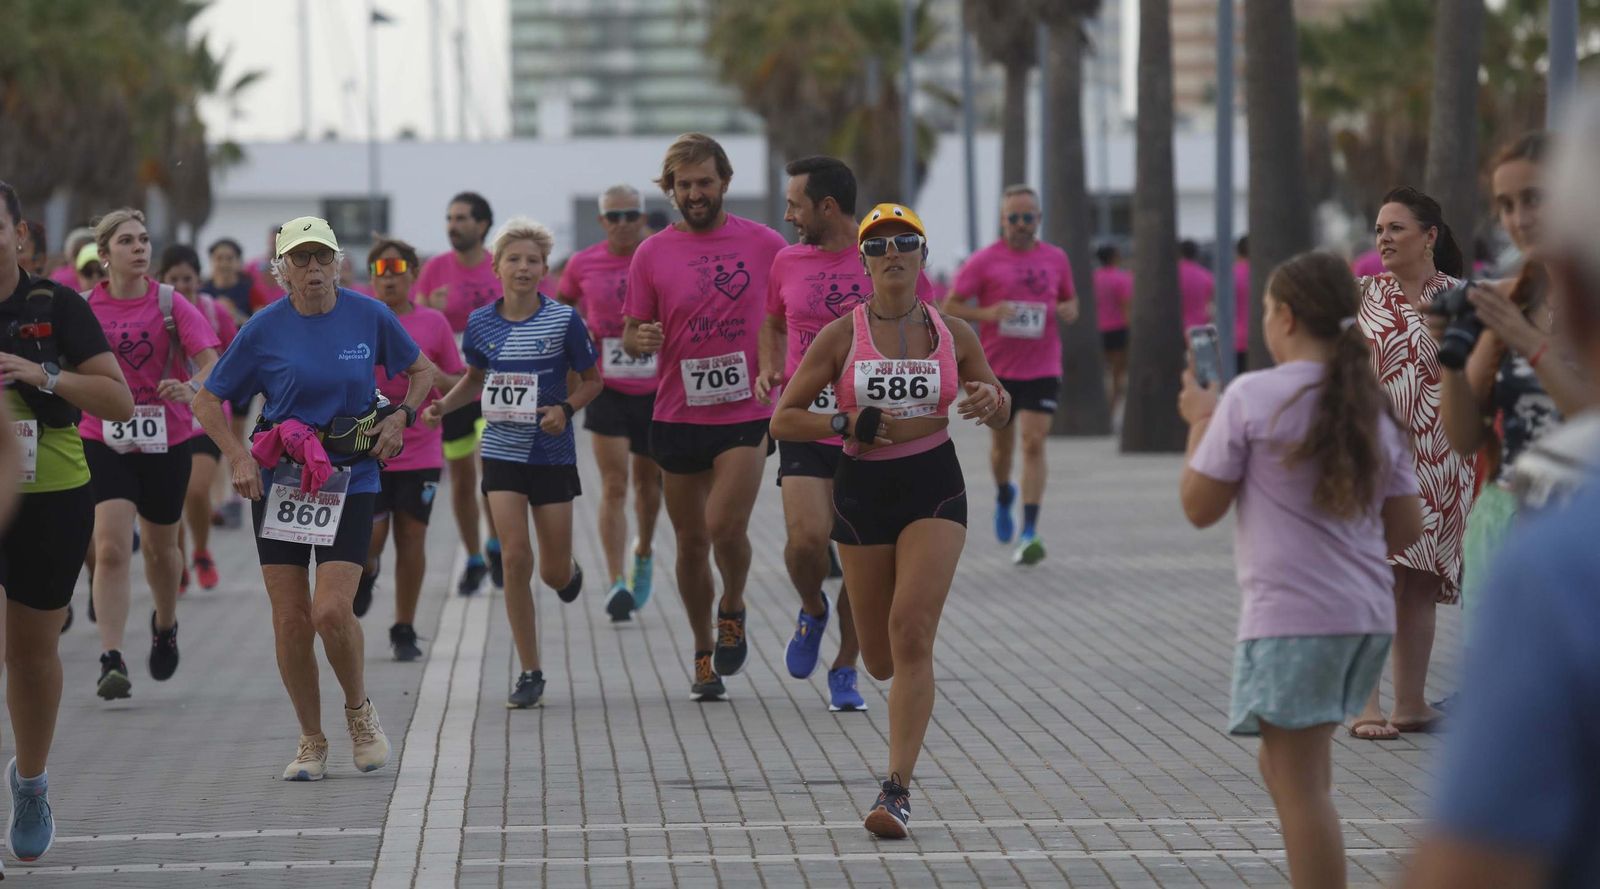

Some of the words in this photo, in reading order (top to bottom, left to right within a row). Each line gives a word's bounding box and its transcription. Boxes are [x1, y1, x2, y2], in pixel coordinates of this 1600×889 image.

[1008, 310, 1040, 327] 61
[690, 366, 740, 391] 706
[875, 367, 894, 376] POR
[896, 367, 907, 375] LA
[908, 366, 937, 375] MUJER
[487, 386, 528, 406] 707
[866, 376, 929, 401] 586
[111, 419, 158, 440] 310
[277, 500, 331, 528] 860
